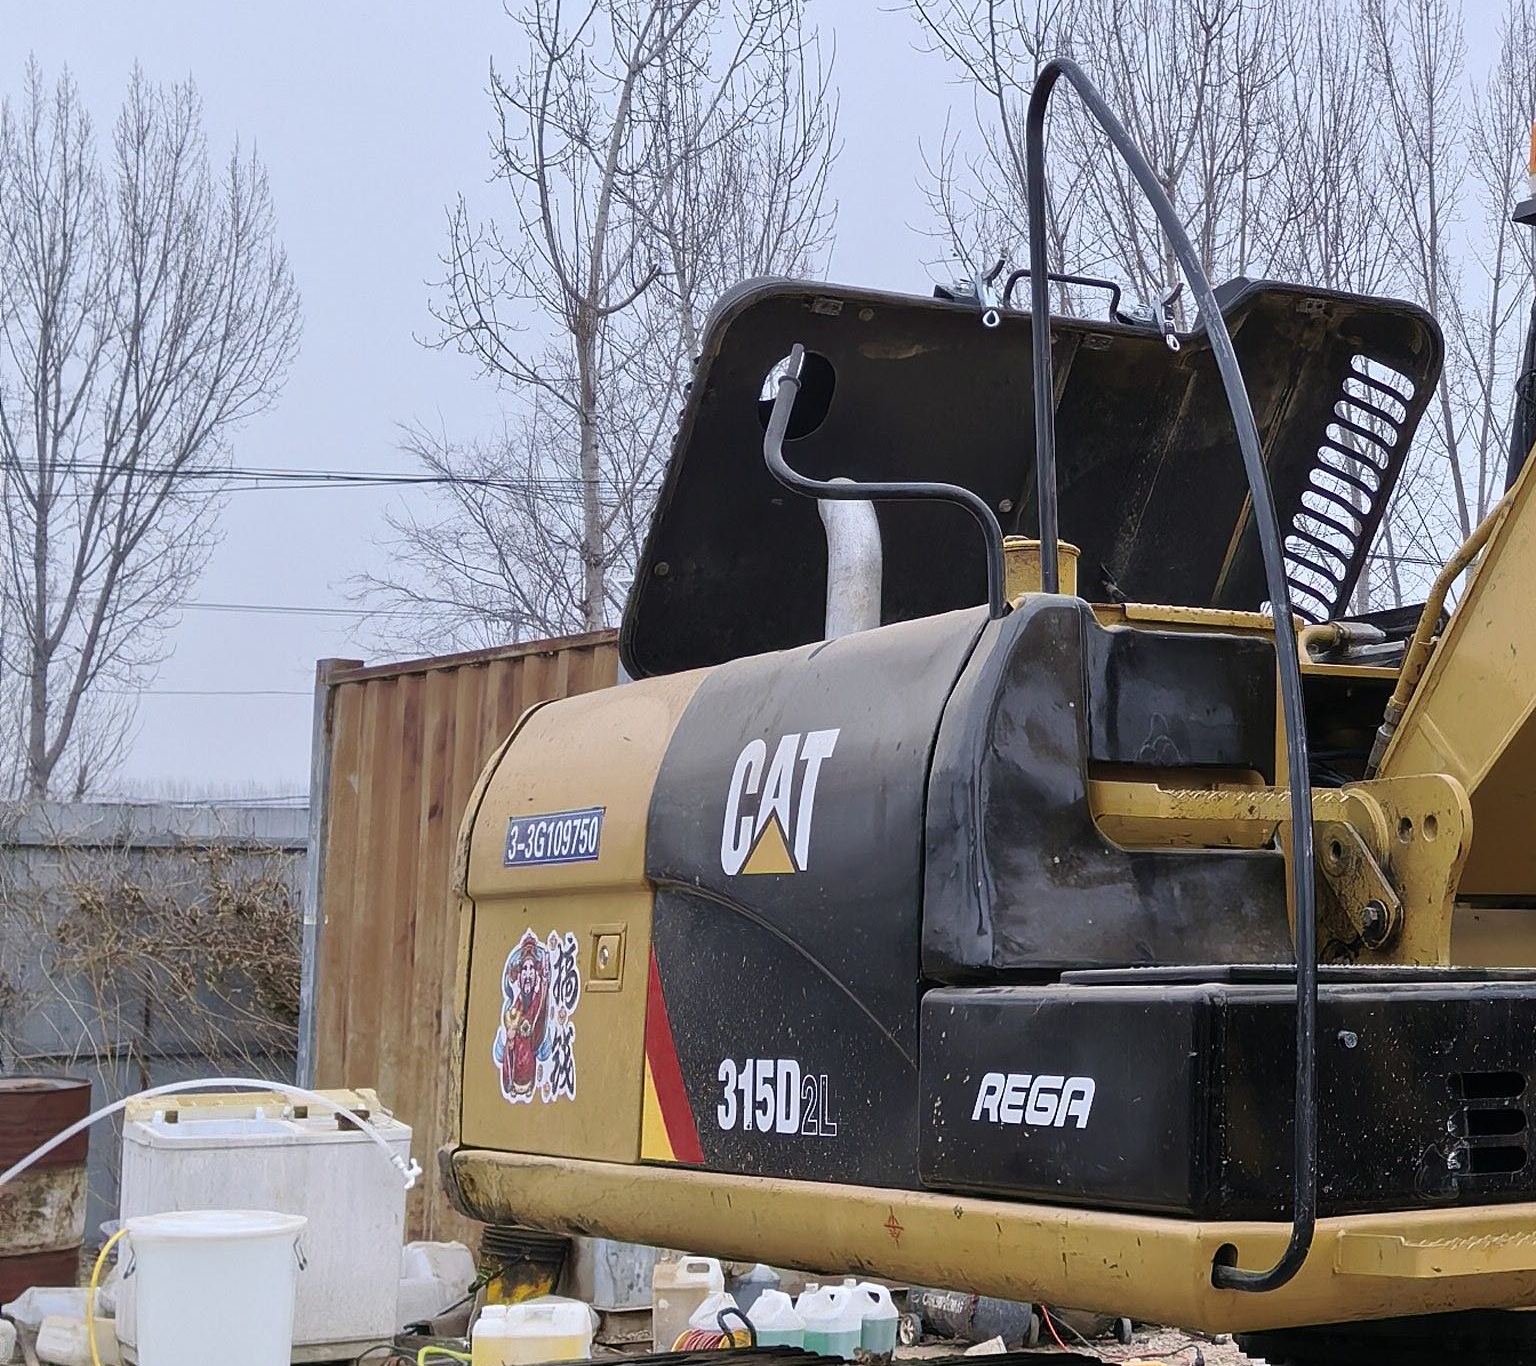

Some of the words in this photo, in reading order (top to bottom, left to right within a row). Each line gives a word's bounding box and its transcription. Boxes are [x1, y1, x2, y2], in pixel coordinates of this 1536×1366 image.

[720, 728, 841, 876] CAT
[508, 816, 599, 860] 3-3G109750
[971, 1072, 1095, 1129] REGA
